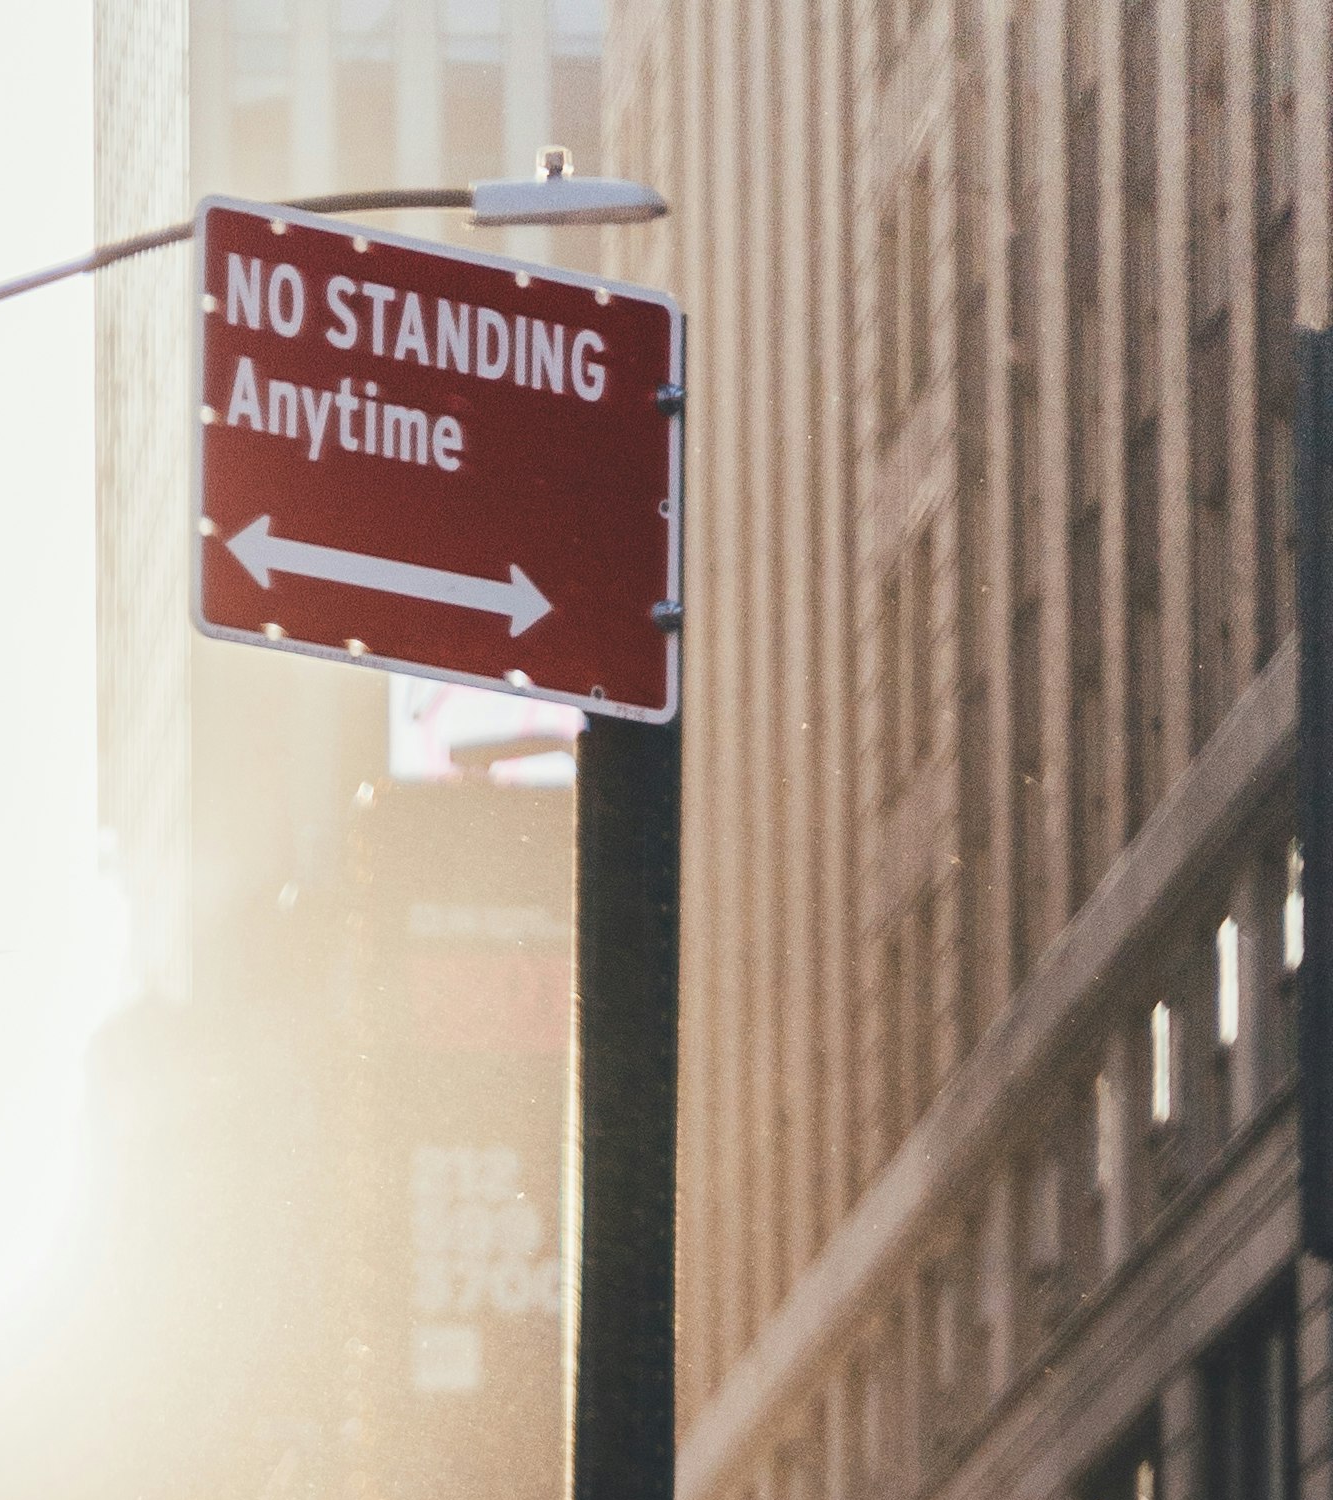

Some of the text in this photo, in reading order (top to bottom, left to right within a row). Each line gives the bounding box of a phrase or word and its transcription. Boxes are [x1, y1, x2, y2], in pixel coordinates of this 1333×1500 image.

[226, 252, 607, 402] NO STANDING
[227, 356, 465, 472] Anytime
